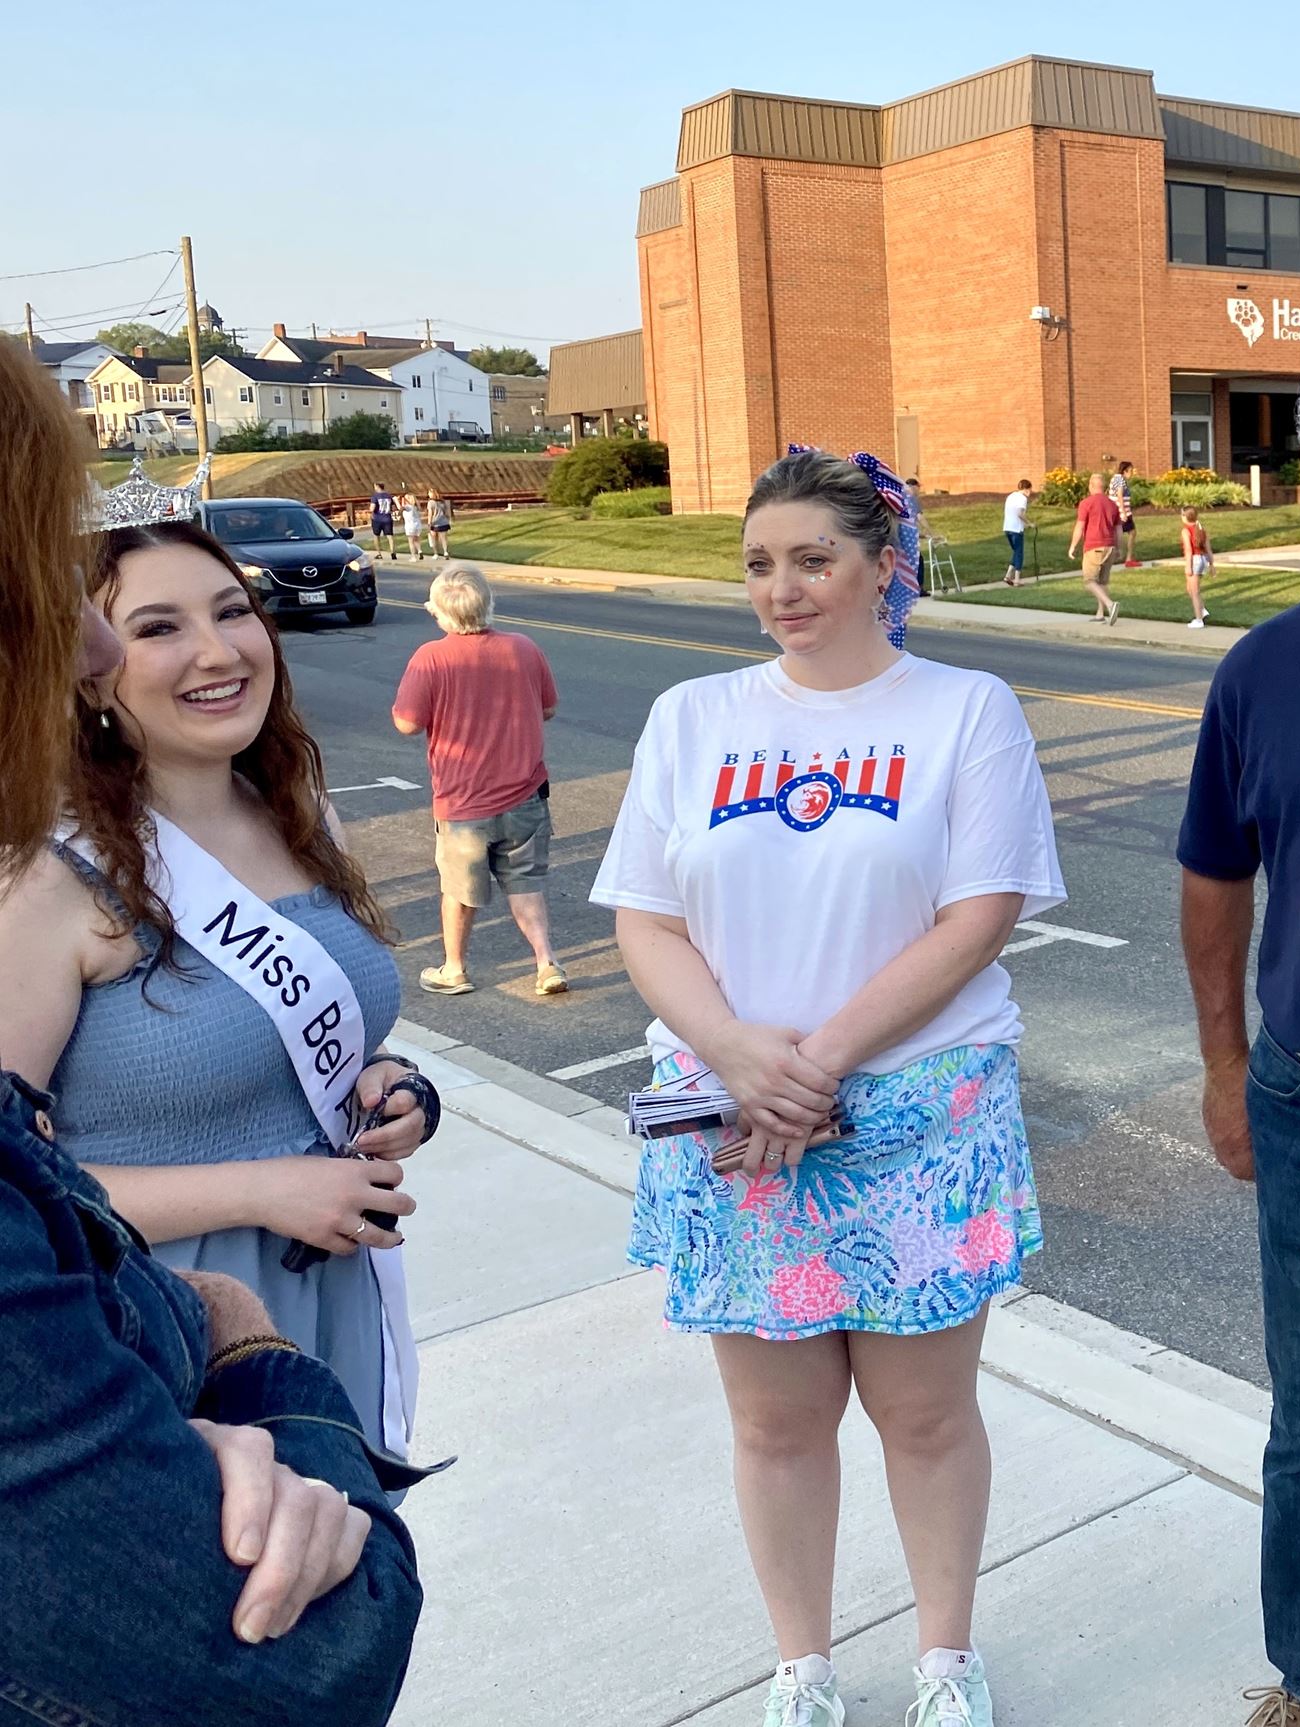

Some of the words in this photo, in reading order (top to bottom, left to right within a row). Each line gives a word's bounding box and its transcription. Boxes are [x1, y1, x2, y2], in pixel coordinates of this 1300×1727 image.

[723, 749, 797, 765] BEL
[836, 744, 906, 760] AIR
[202, 900, 311, 1007] Miss
[302, 1000, 355, 1090] Bel
